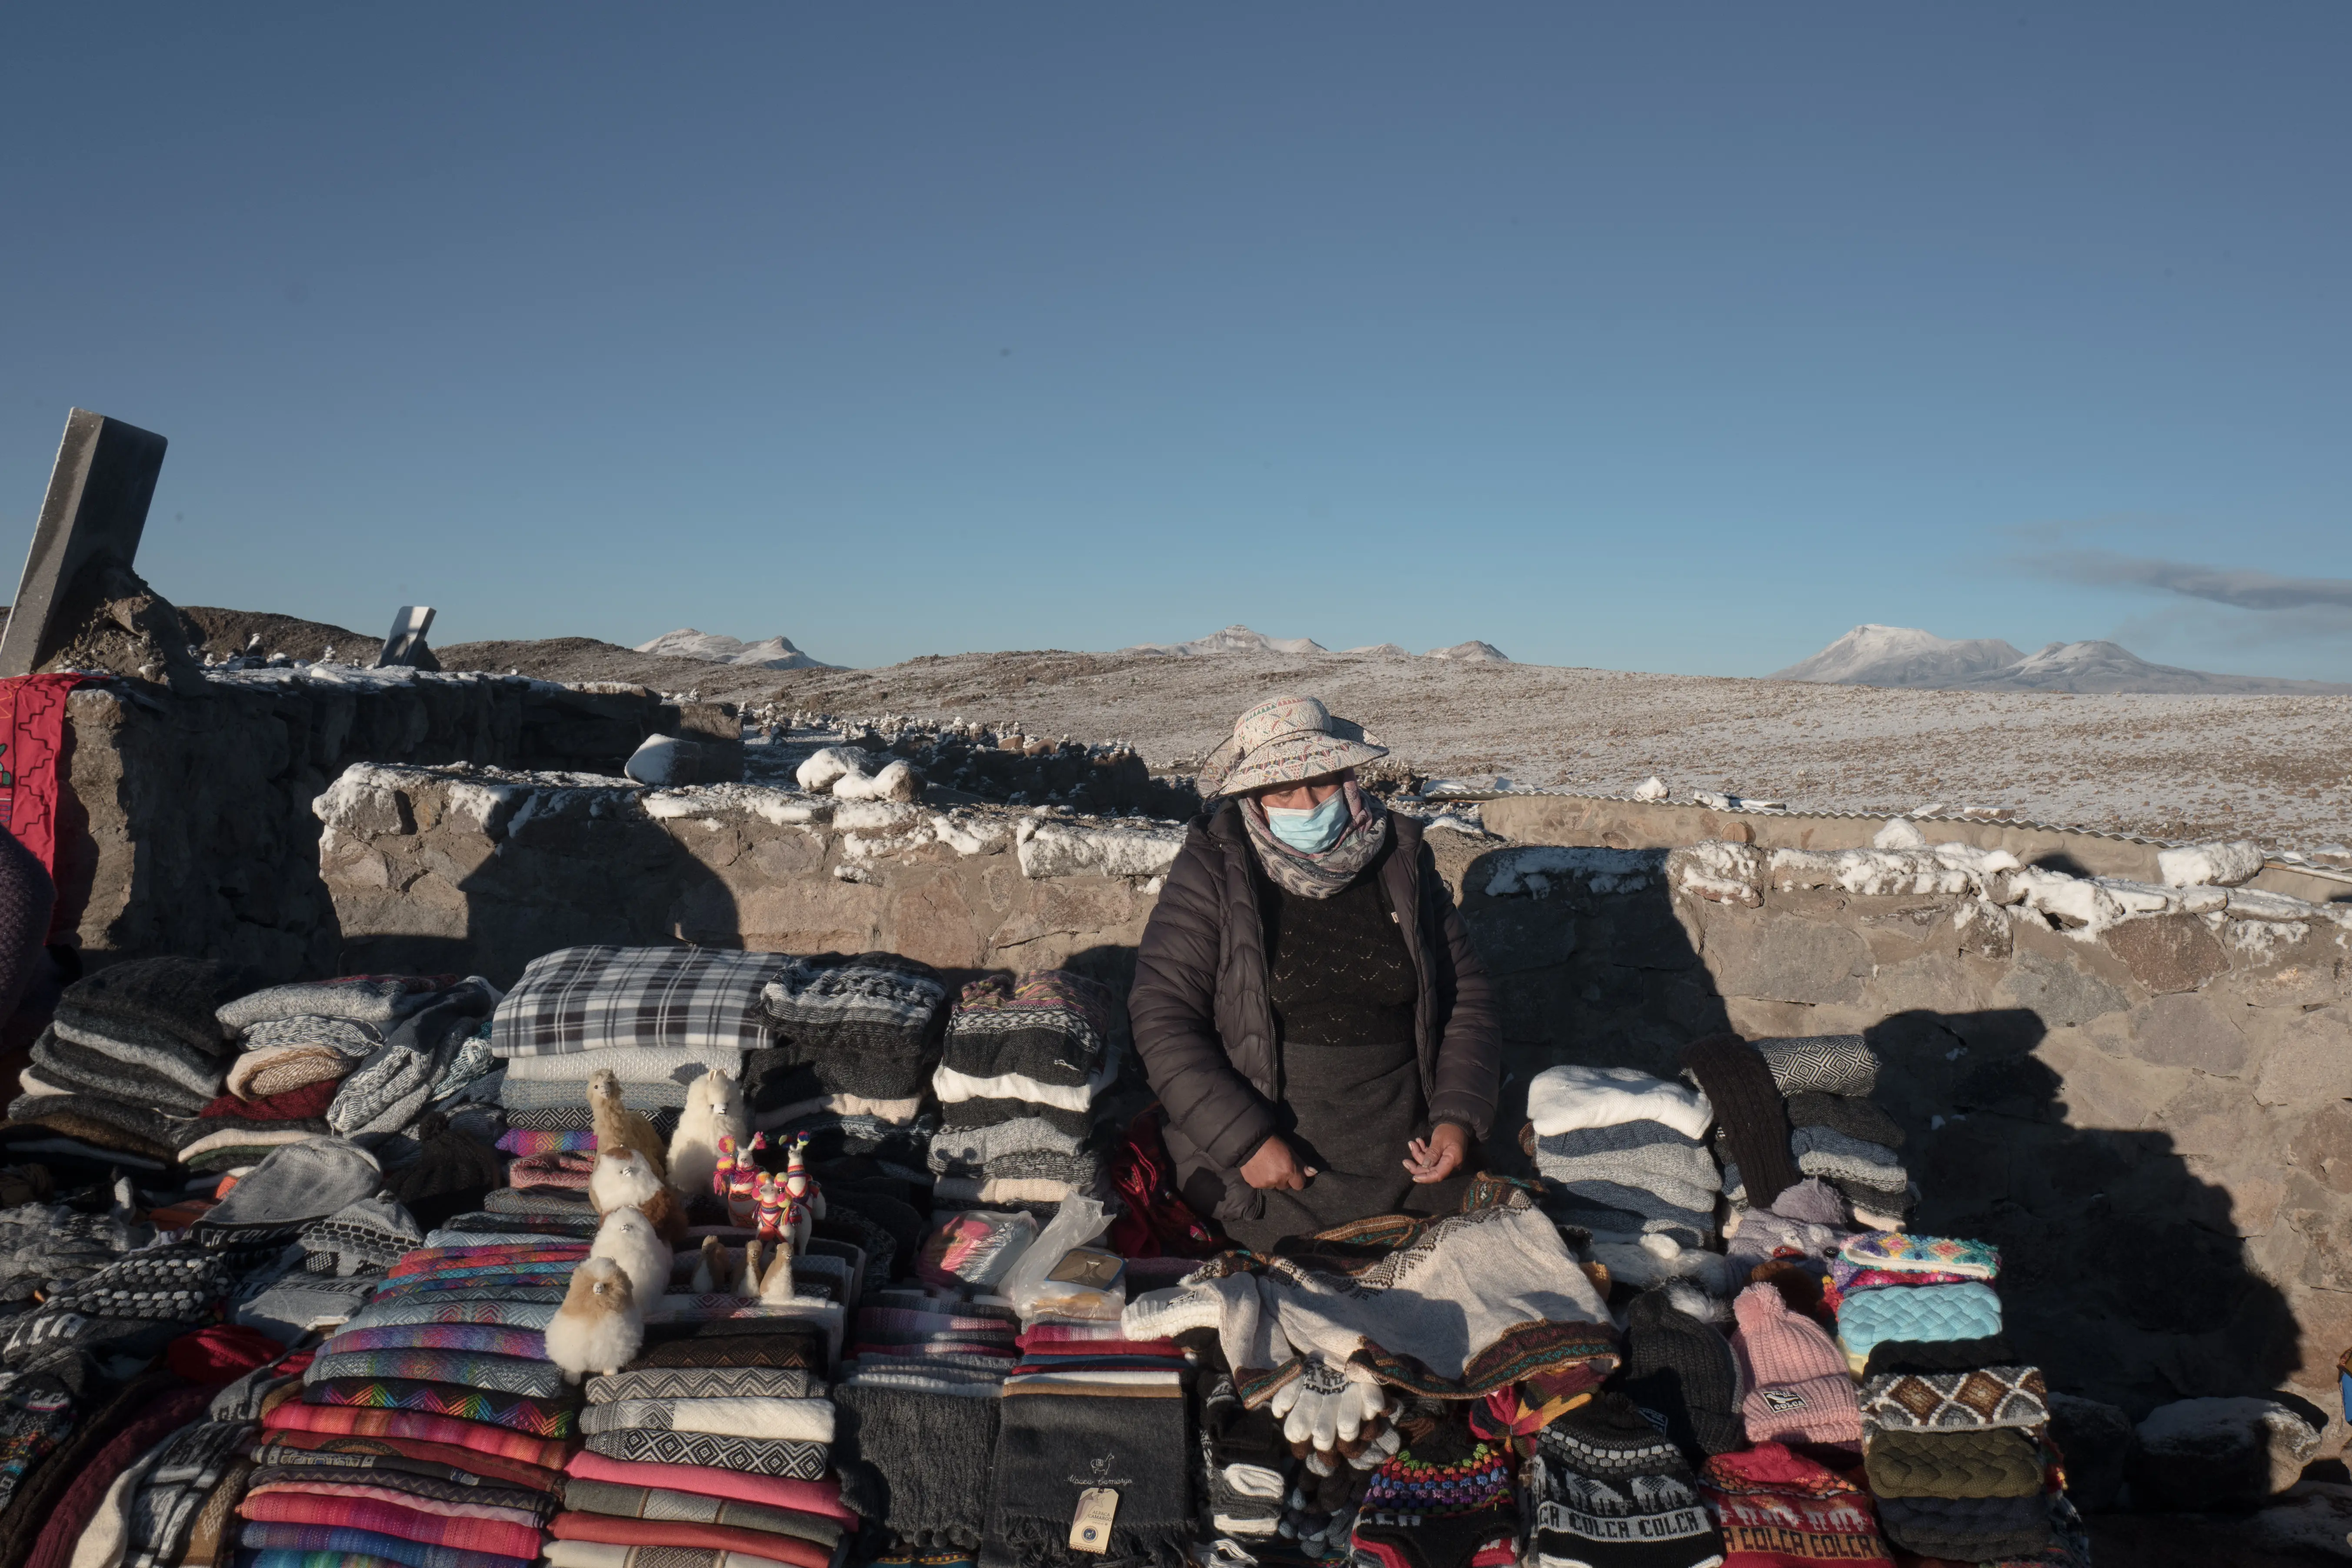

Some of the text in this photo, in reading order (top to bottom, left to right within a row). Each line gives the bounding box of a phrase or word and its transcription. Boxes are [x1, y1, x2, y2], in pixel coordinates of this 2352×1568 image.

[307, 1283, 361, 1293] COLCA
[1774, 1401, 1805, 1410] COLCA
[1064, 1474, 1133, 1486] Alpaca Camargo
[1088, 1514, 1112, 1522] CAMARGO
[1568, 1512, 1630, 1538] COLCA
[1638, 1511, 1699, 1537] COLCA
[1740, 1527, 1807, 1555] COLCA
[1810, 1534, 1874, 1558] COLCA
